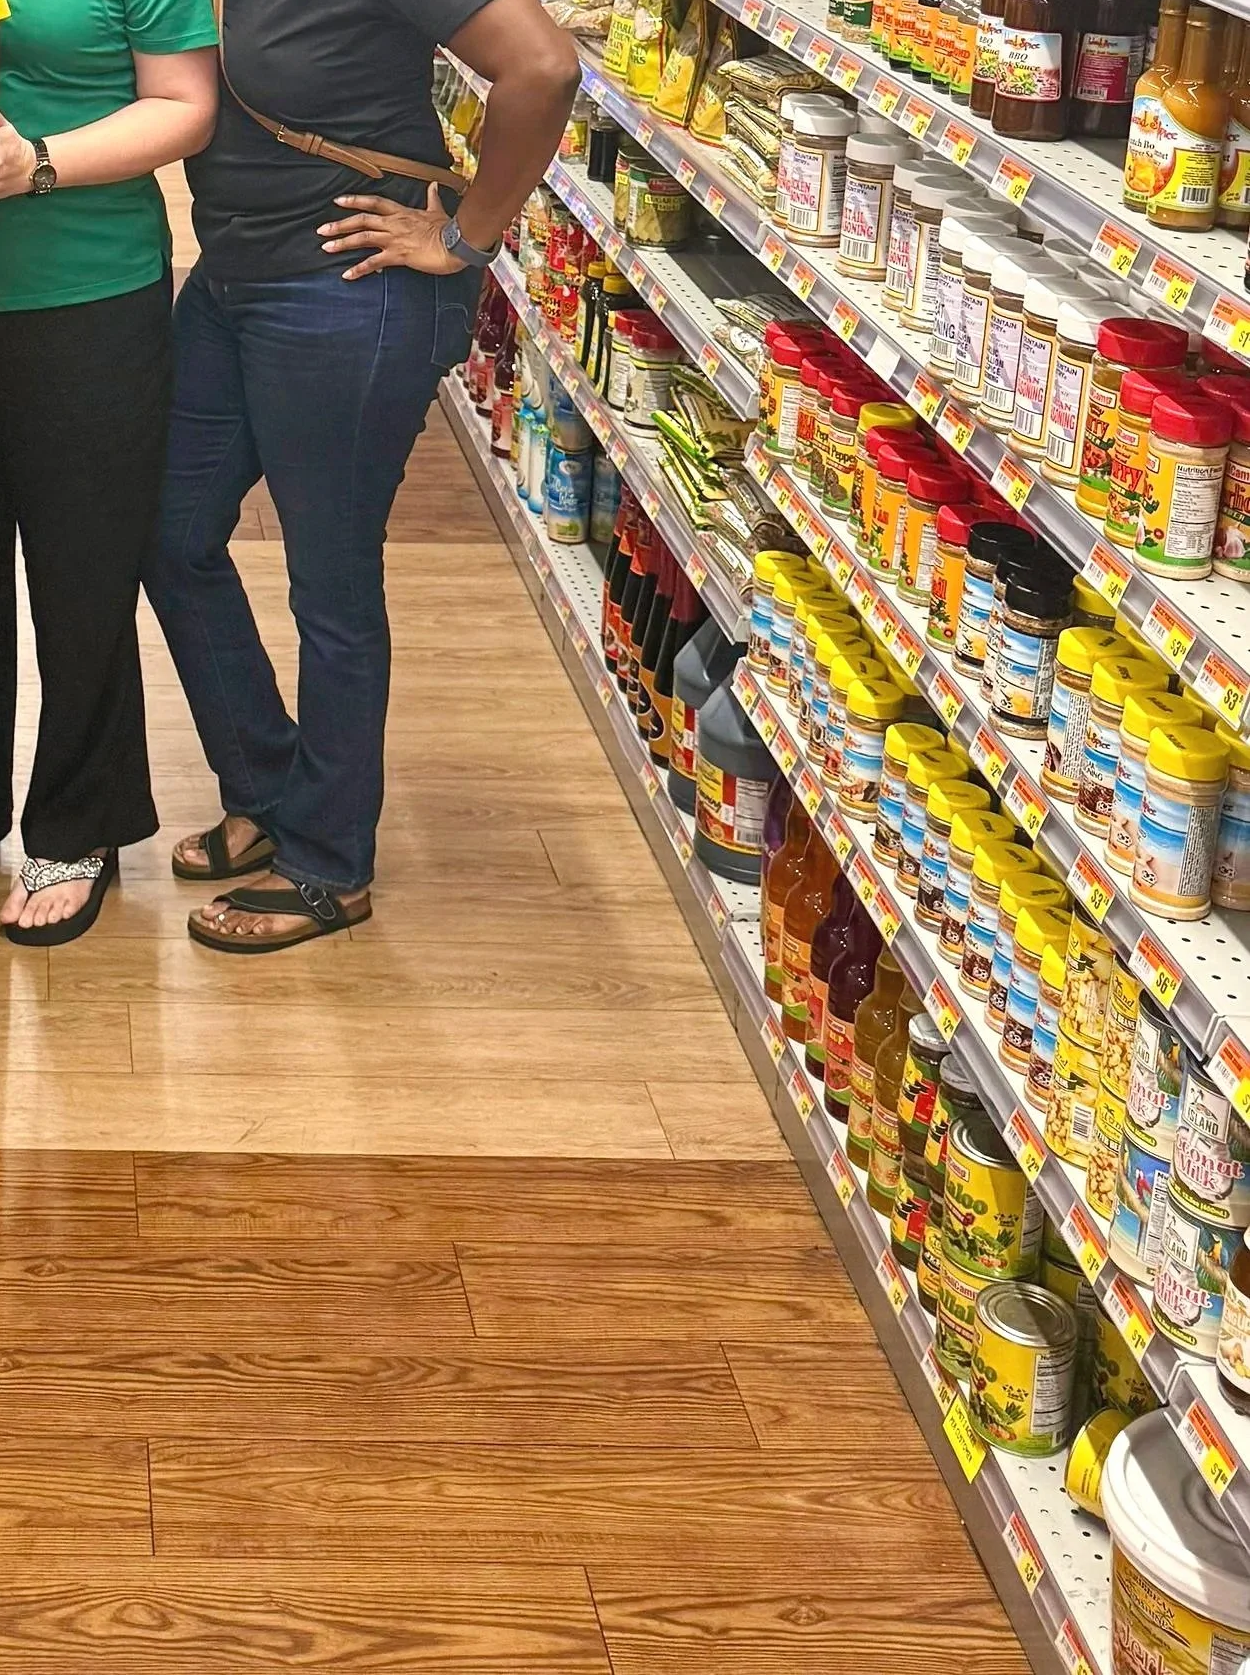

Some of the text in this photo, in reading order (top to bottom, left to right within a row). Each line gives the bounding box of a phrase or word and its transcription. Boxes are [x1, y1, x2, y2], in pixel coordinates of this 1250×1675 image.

[1014, 61, 1040, 72] Sauce
[1177, 465, 1209, 475] Nutrition
[1187, 1106, 1220, 1138] ISLAND
